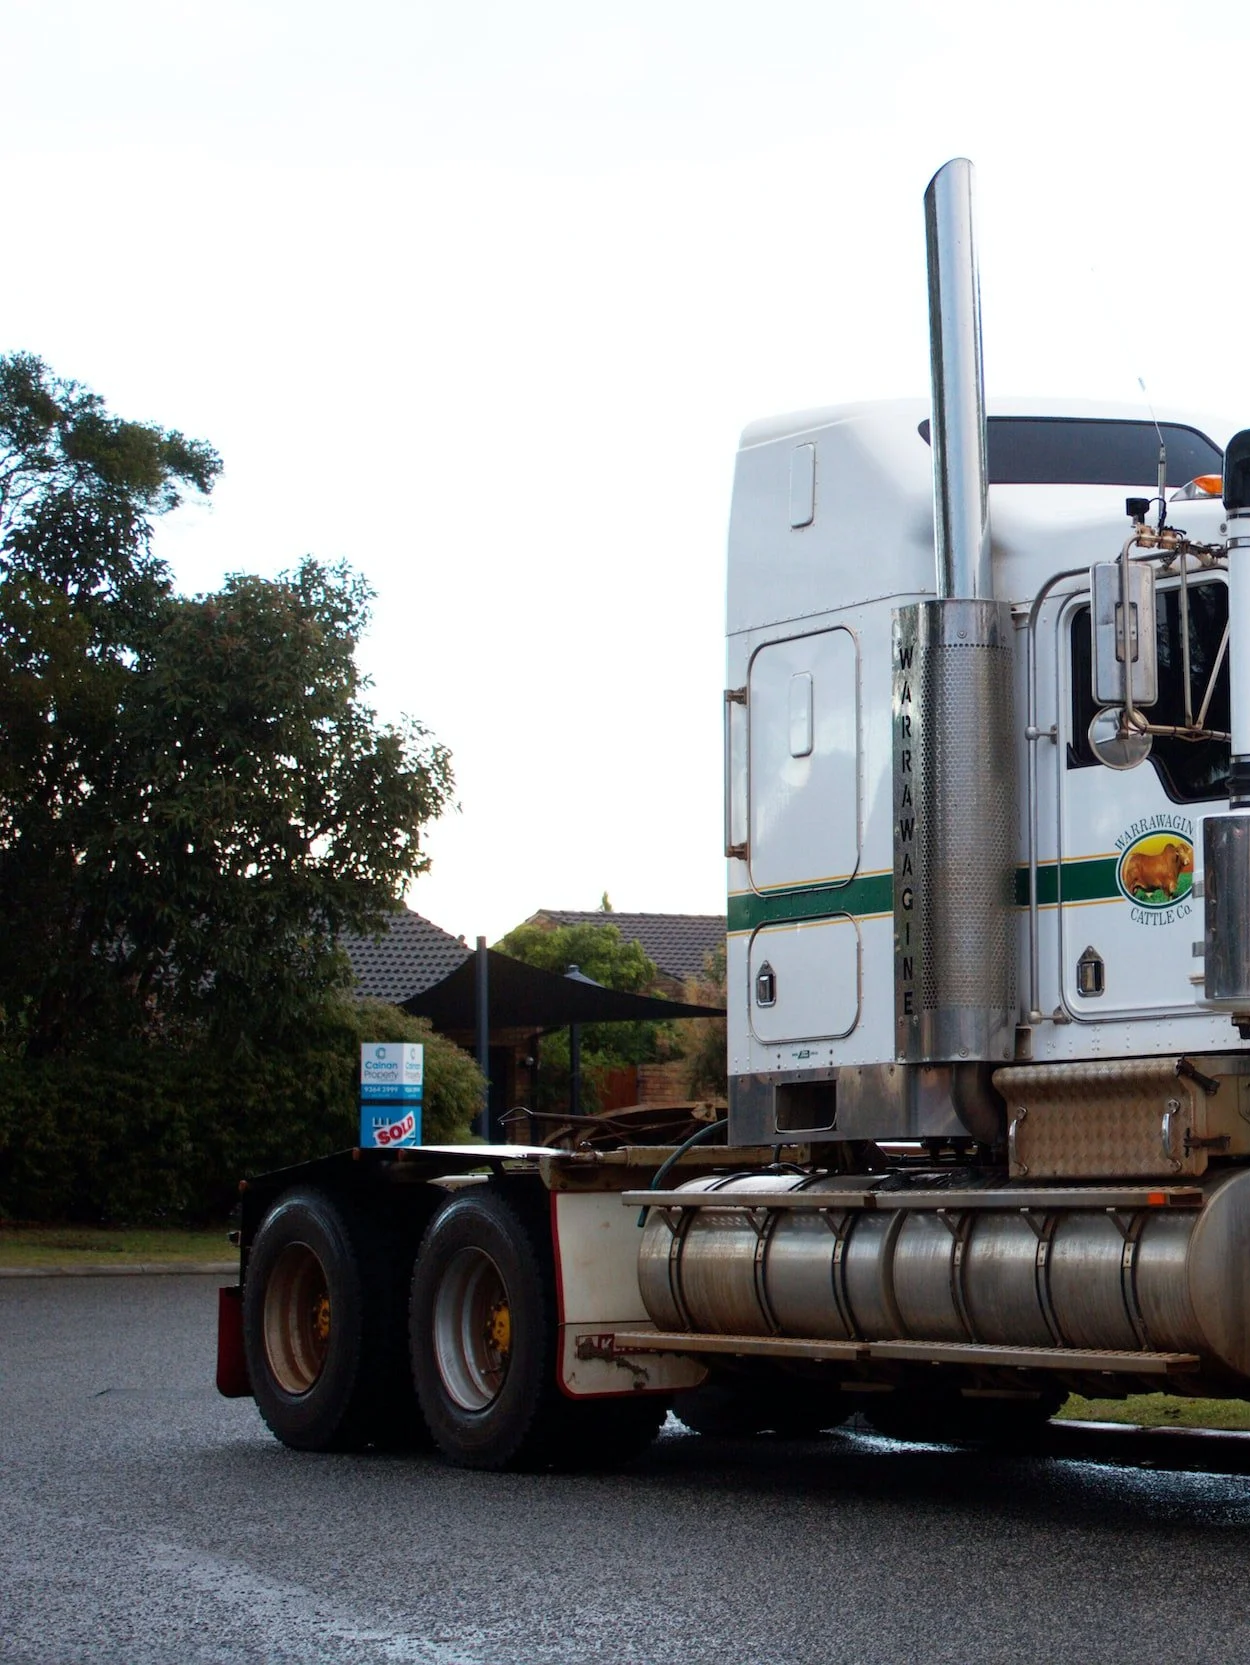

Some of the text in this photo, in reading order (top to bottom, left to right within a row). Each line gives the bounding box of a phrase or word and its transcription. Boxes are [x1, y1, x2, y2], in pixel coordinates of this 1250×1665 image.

[899, 646, 914, 1016] WARRAWAGINE
[1130, 904, 1193, 926] CATTLE Co.
[364, 1070, 399, 1080] Property
[376, 1115, 414, 1146] SOLD
